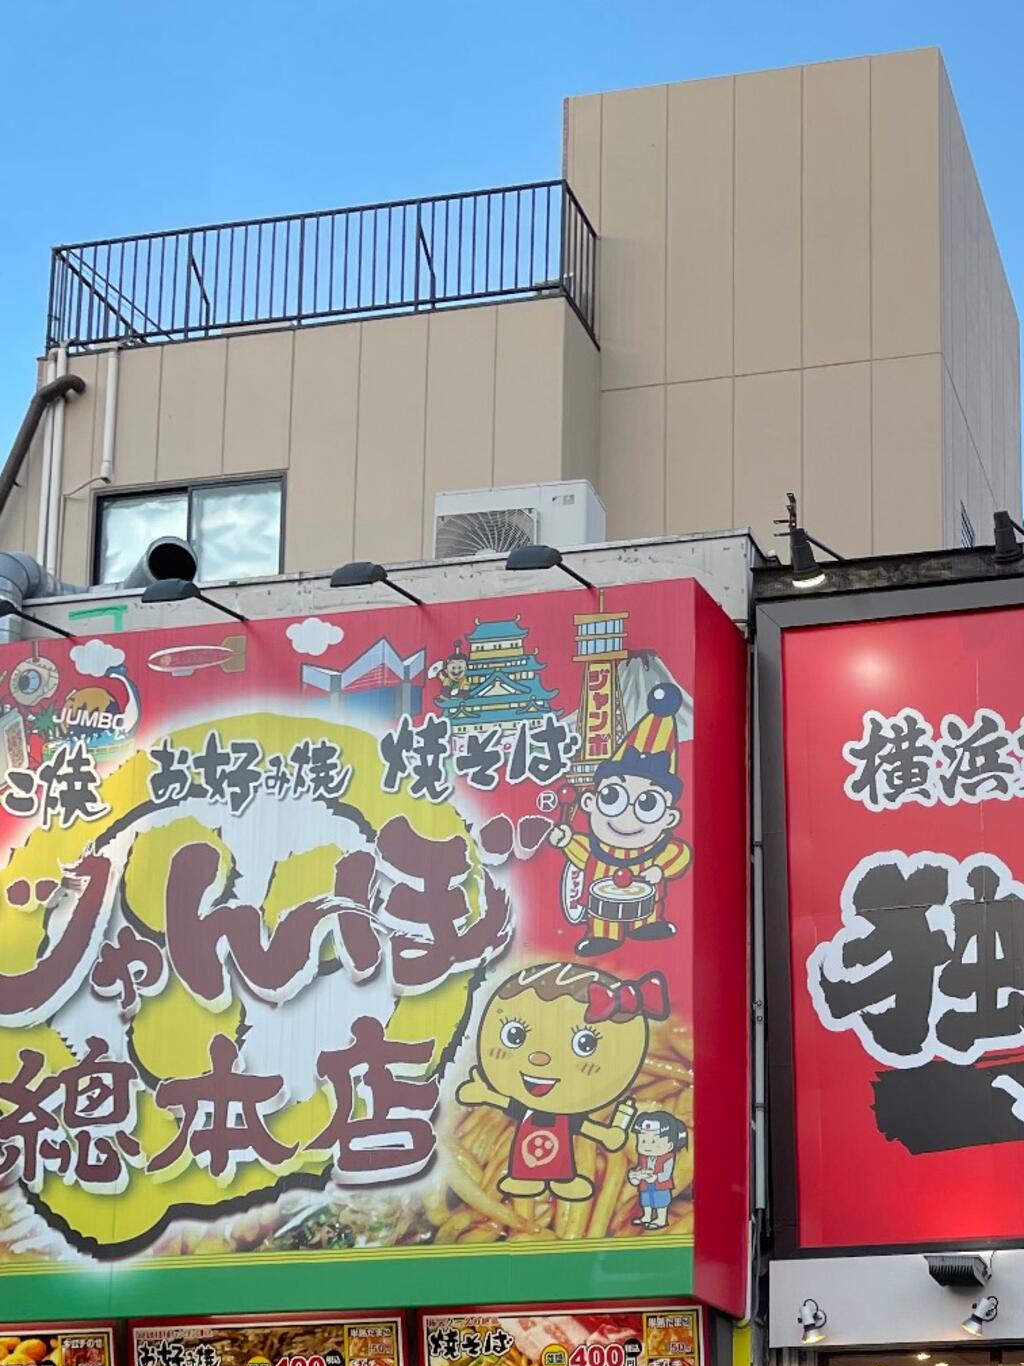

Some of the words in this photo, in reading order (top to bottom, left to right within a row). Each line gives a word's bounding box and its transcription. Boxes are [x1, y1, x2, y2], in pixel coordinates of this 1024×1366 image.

[587, 667, 611, 757] ジャンボ
[146, 735, 356, 817] お好み焼
[378, 714, 581, 804] 焼そば
[428, 1327, 515, 1361] 焼そば
